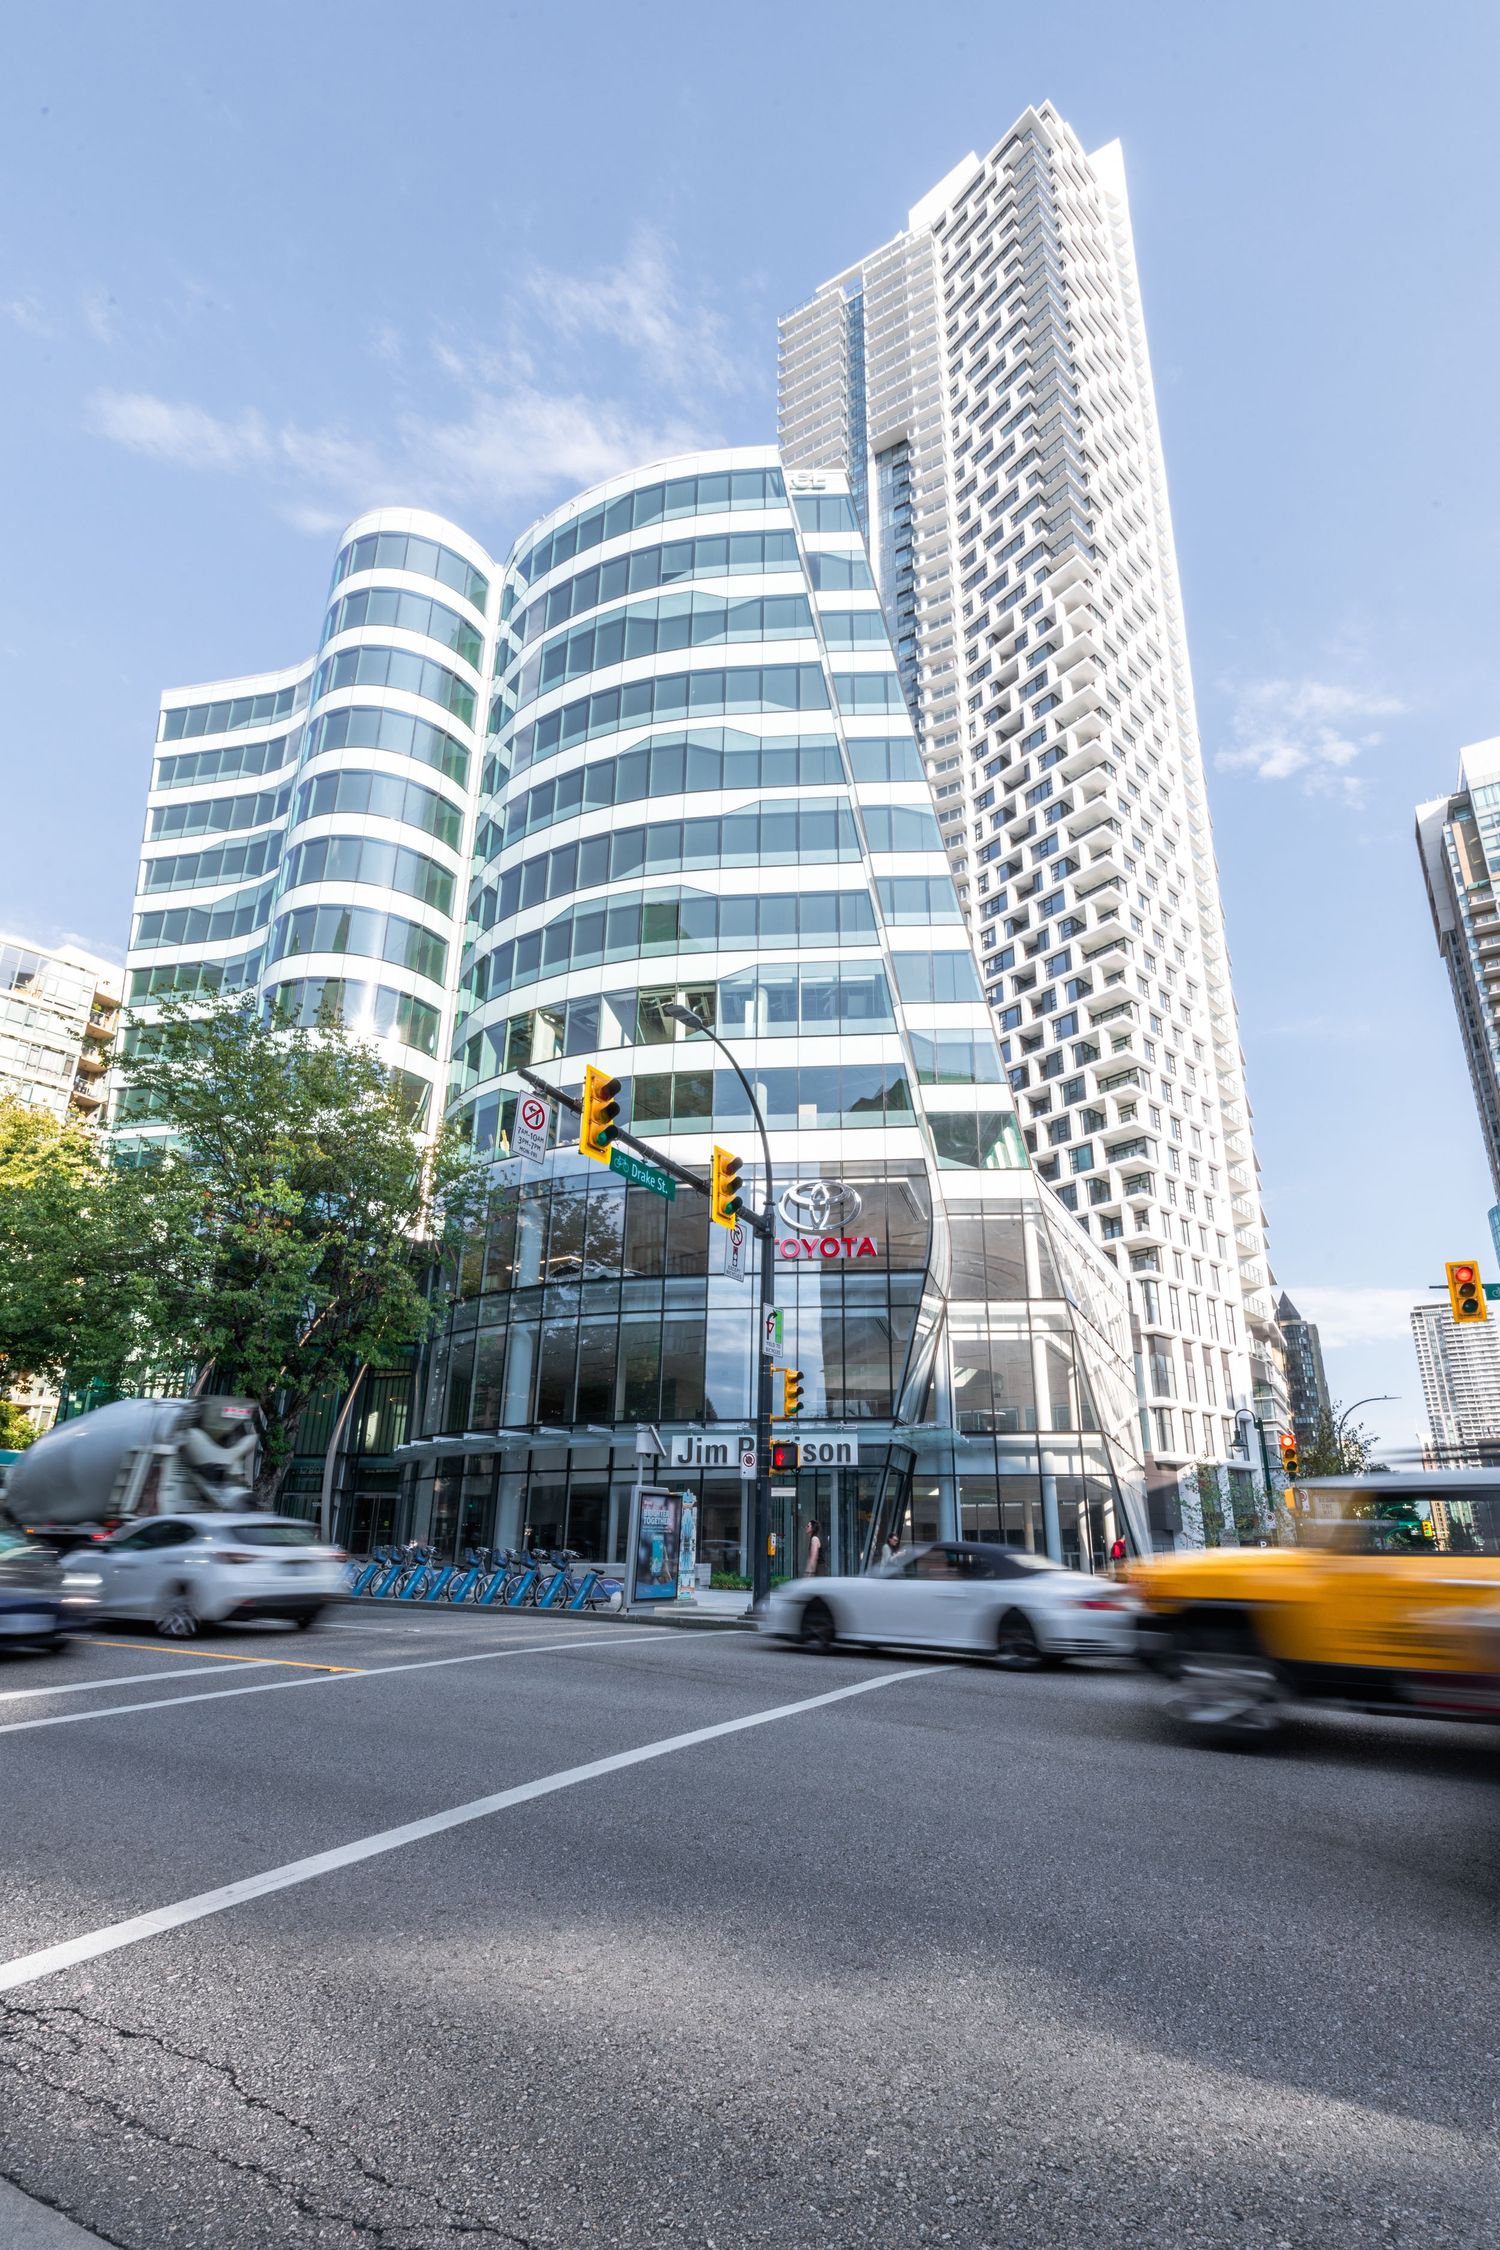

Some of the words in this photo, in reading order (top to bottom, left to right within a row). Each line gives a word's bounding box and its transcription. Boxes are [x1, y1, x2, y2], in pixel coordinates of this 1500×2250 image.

[631, 1163, 656, 1188] Drake
[657, 1177, 668, 1194] St.
[774, 1236, 878, 1259] OYOTA
[677, 1437, 728, 1464] Jim
